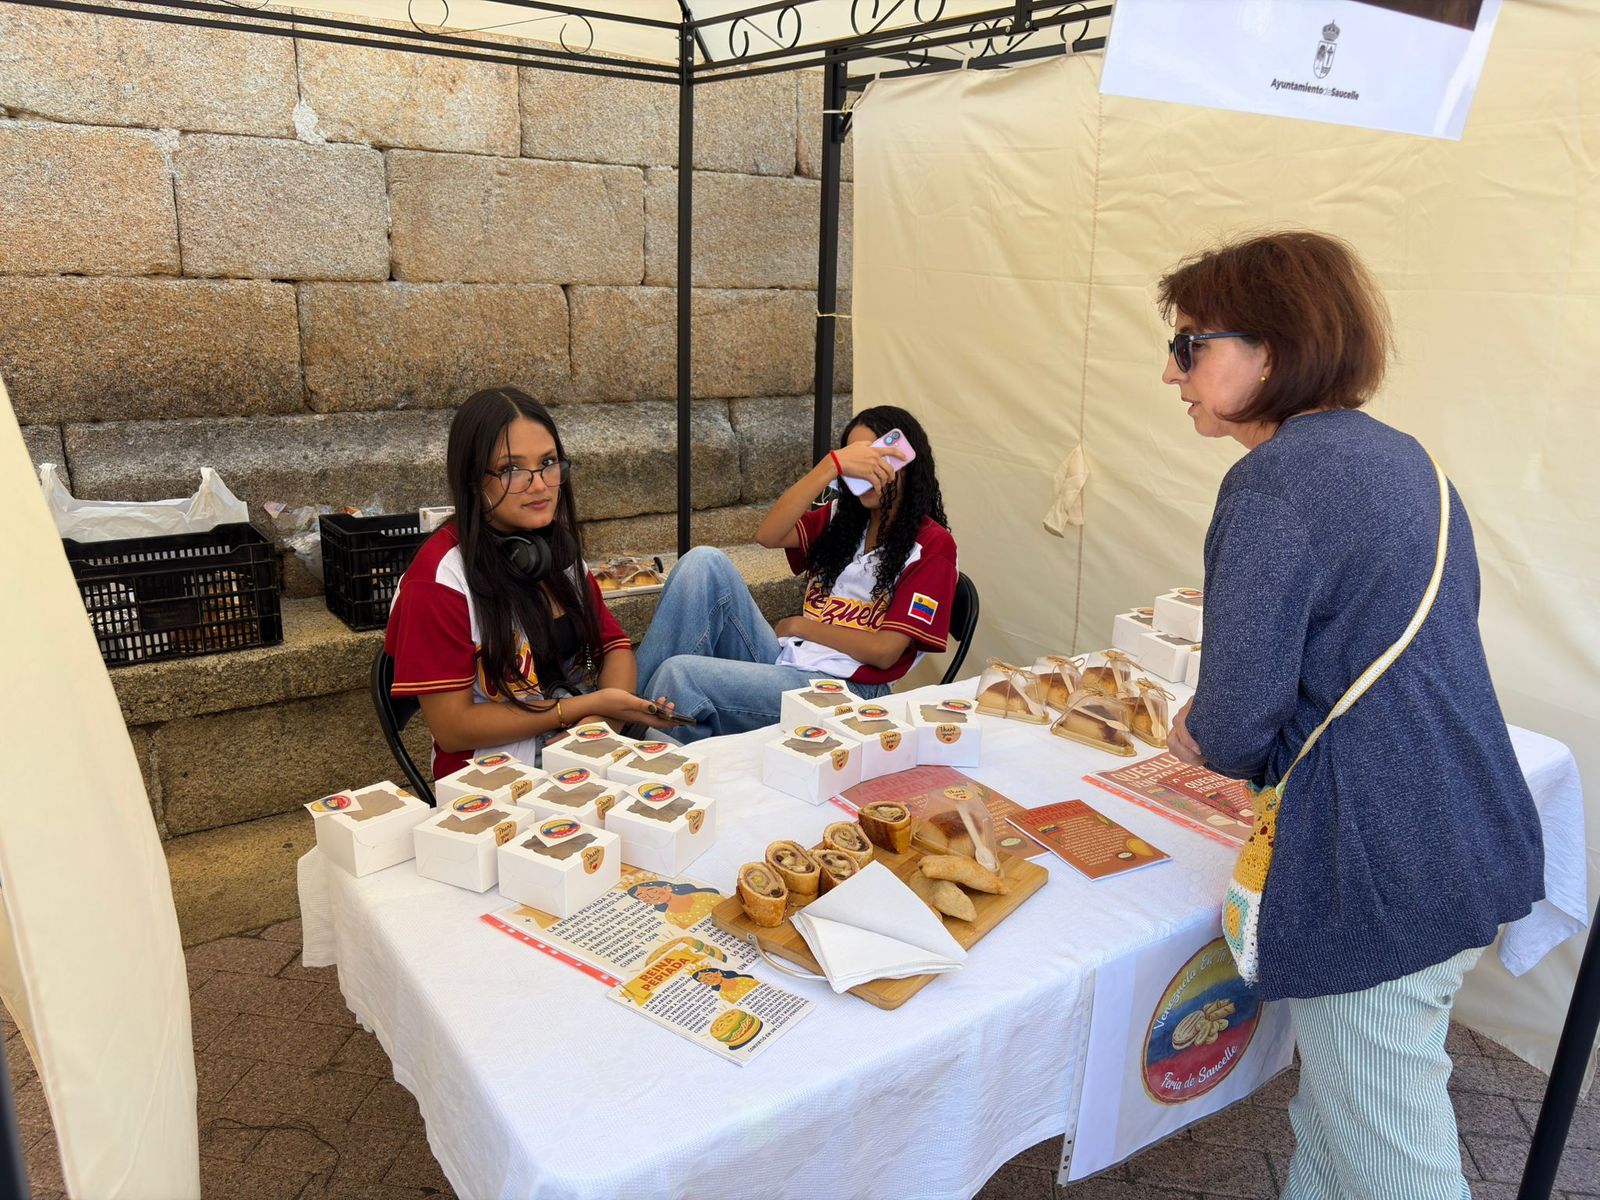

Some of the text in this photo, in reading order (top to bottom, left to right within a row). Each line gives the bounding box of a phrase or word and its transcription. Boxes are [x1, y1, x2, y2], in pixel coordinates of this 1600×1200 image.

[1270, 78, 1324, 95] Ayuntamiento
[1331, 88, 1359, 101] Saucelle
[1113, 754, 1181, 781] QUESILL
[553, 892, 630, 936] UNA AREPA VENEZOLANA
[556, 913, 580, 927] REINA
[577, 896, 609, 914] PEPIADA
[591, 913, 608, 922] 1955
[569, 929, 595, 944] HONOR
[598, 911, 625, 927] SUSANA
[586, 925, 629, 951] VENEZOLANA,
[626, 914, 647, 926] QUIEN
[587, 924, 617, 942] PRIMERA
[614, 915, 632, 925] MISS
[594, 916, 658, 955] CONSIDERADA MUJER
[633, 931, 648, 939] (ES
[610, 944, 642, 963] HERMOSA
[644, 932, 660, 942] CON
[640, 958, 674, 982] REINA
[641, 957, 690, 992] PEPIADA
[1153, 969, 1197, 1030] Venezuela
[1161, 1046, 1238, 1090] Feria de Saucelle
